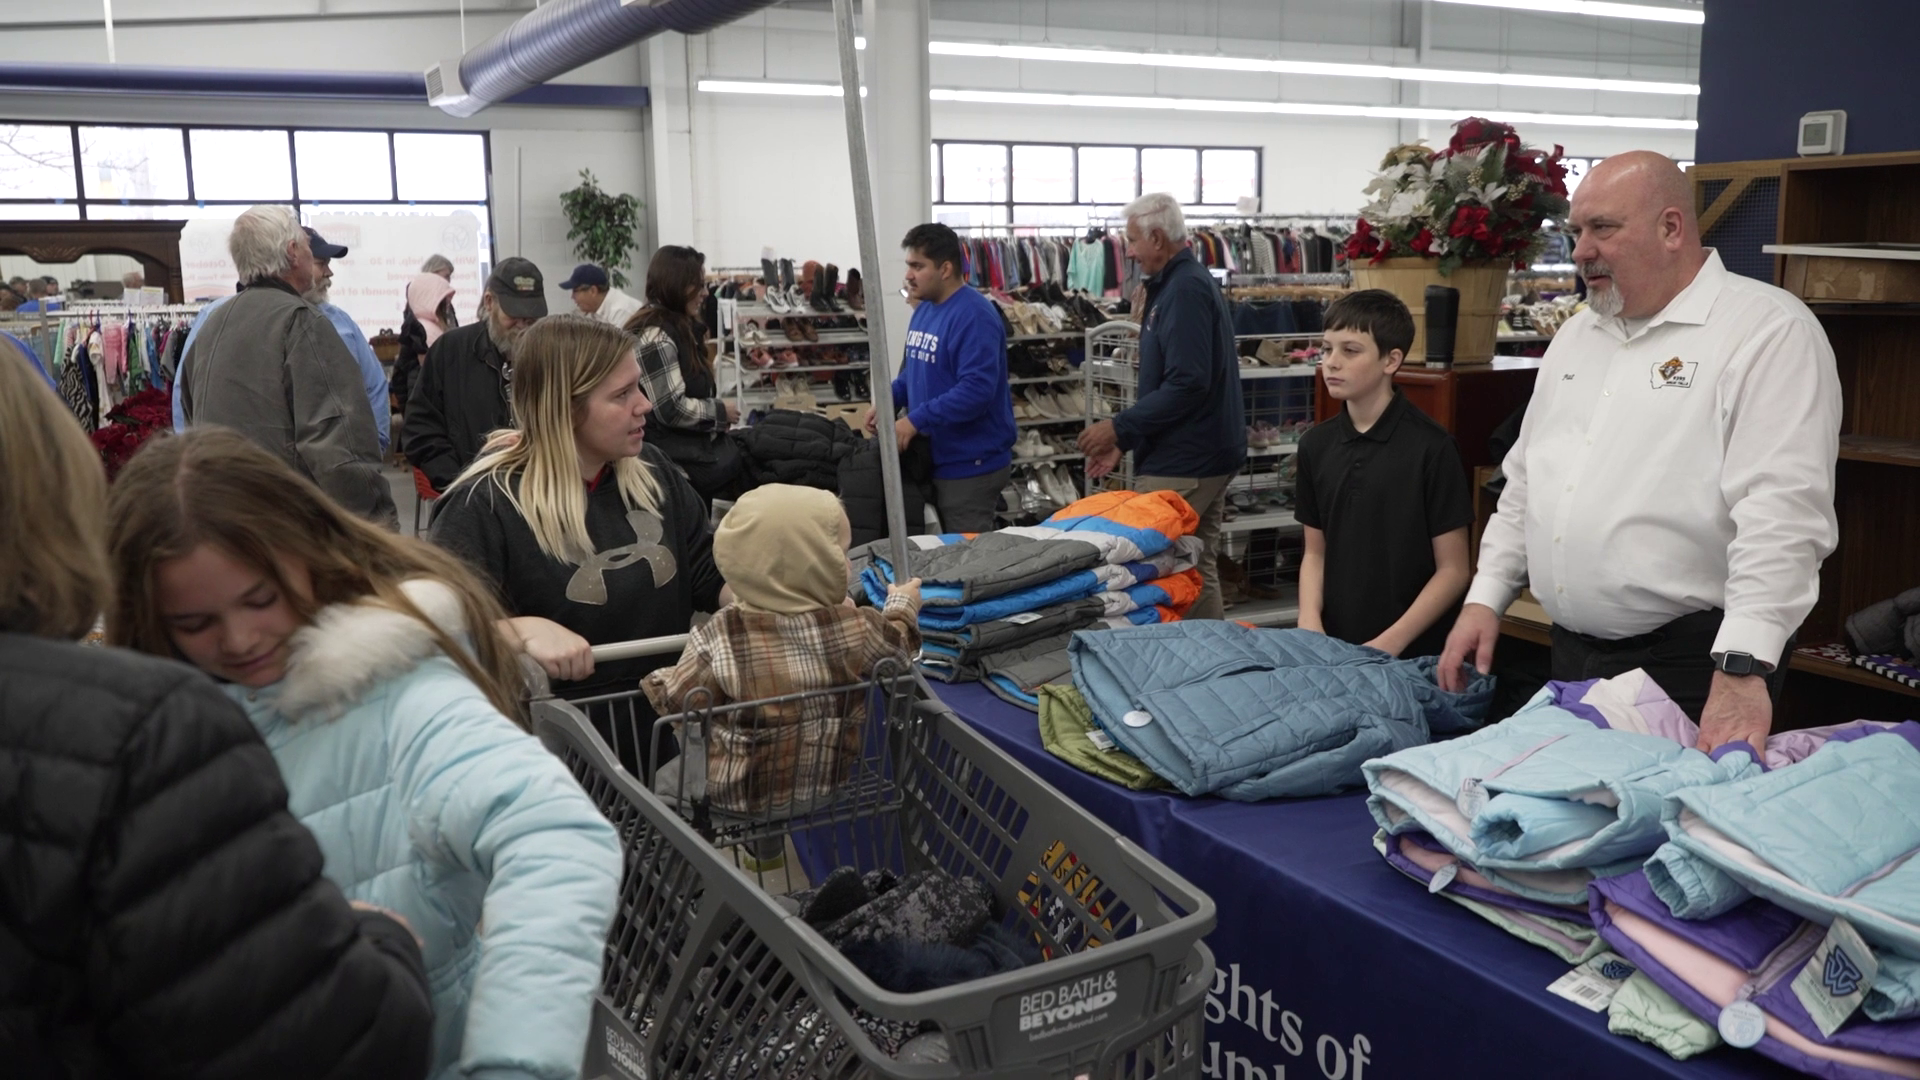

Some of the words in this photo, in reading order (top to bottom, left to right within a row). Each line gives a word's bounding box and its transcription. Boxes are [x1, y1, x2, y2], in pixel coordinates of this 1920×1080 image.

[1019, 991, 1117, 1031] BEYOND
[1020, 990, 1056, 1015] BED
[1058, 974, 1102, 1006] BATH
[1104, 970, 1117, 990] &
[605, 1025, 620, 1048] BED
[1204, 963, 1303, 1057] ghts
[1316, 1033, 1372, 1080] of
[606, 1042, 648, 1080] BEYOND
